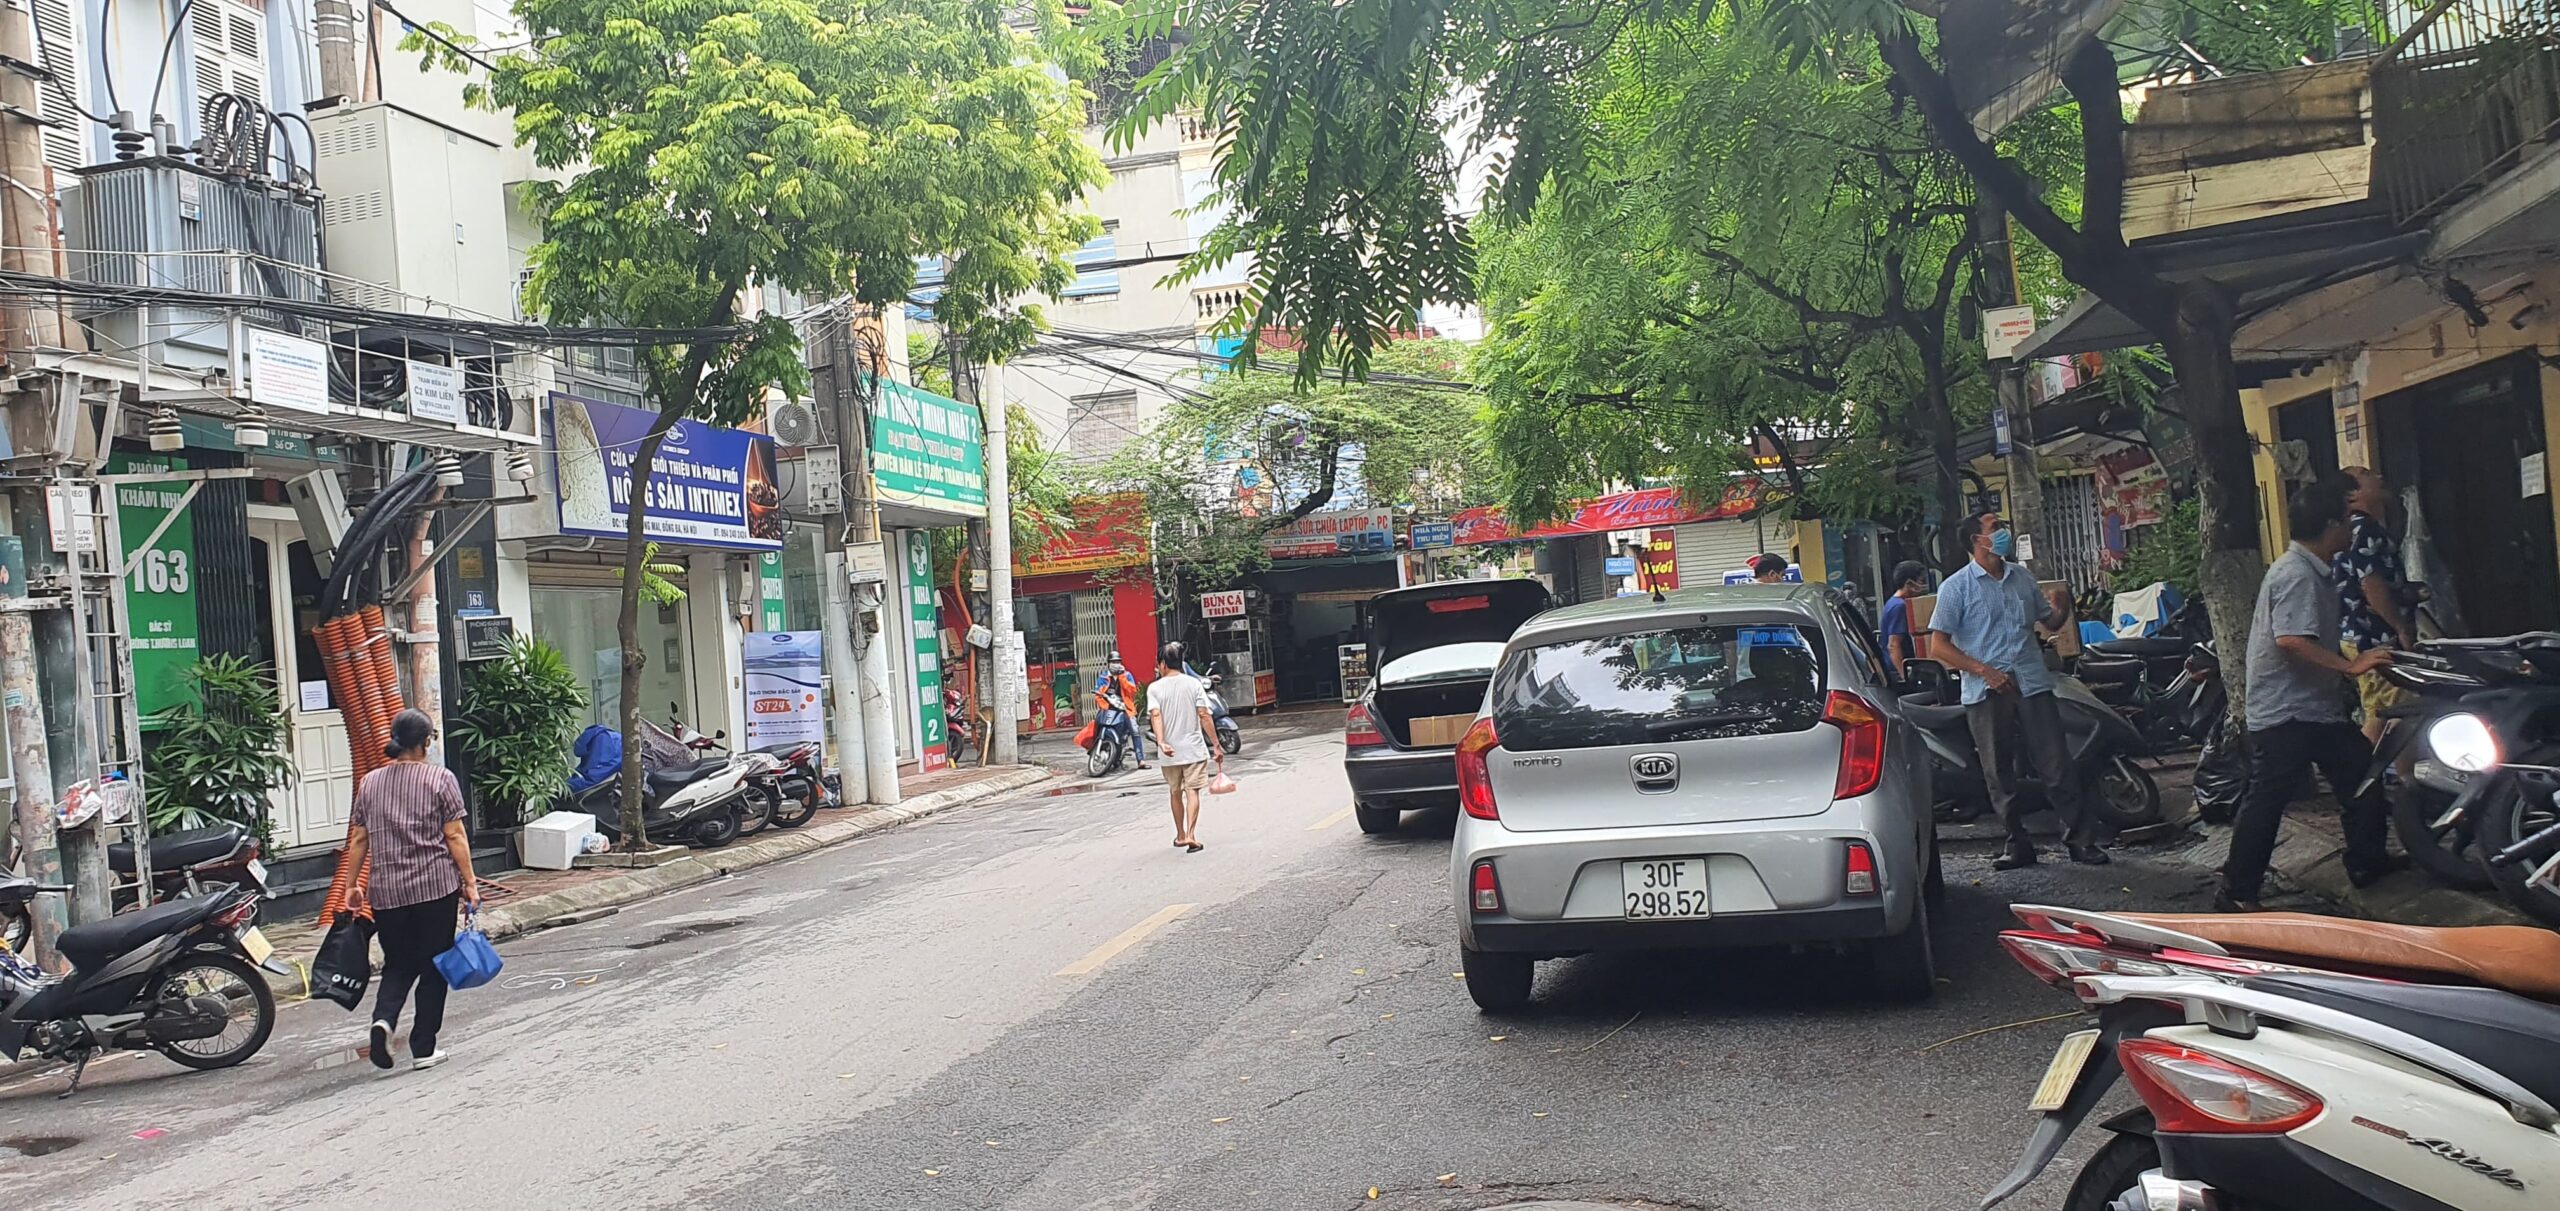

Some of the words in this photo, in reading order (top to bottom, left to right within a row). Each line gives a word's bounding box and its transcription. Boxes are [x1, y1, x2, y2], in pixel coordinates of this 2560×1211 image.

[414, 385, 423, 396] C2
[425, 388, 437, 398] KIM
[439, 390, 454, 401] LIÊN
[888, 390, 921, 430] THUỐC
[921, 401, 948, 436] MINH
[947, 407, 970, 448] NHẬT
[971, 418, 979, 445] 2
[610, 447, 628, 468] CỬA
[651, 455, 668, 474] GIỚI
[668, 459, 690, 479] THIỆU
[691, 462, 701, 479] VÀ
[120, 486, 158, 508] KHÁM
[612, 471, 655, 508] NÔG
[657, 476, 685, 511] SẢN
[688, 486, 742, 517] INTIMEX
[1298, 516, 1314, 535] SỬA
[1316, 515, 1337, 534] CHỮA
[1339, 516, 1369, 533] LAPTOP
[1377, 514, 1388, 530] PC
[1414, 525, 1430, 534] NHÀ
[1416, 535, 1430, 543] THU
[127, 548, 189, 595] 163
[469, 593, 482, 607] 163
[913, 582, 931, 605] NHÀ
[1203, 593, 1226, 608] BÚN
[1227, 591, 1242, 606] CÁ
[1207, 606, 1239, 616] TRỊNH
[914, 616, 937, 640] THUỐC
[918, 652, 937, 672] MINH
[921, 681, 939, 708] NHẬT
[755, 700, 785, 712] ST24
[928, 718, 939, 742] 2
[1513, 755, 1562, 768] morning
[1640, 761, 1668, 774] KIA
[1642, 861, 1686, 889] 30F
[1626, 889, 1707, 918] 298.52
